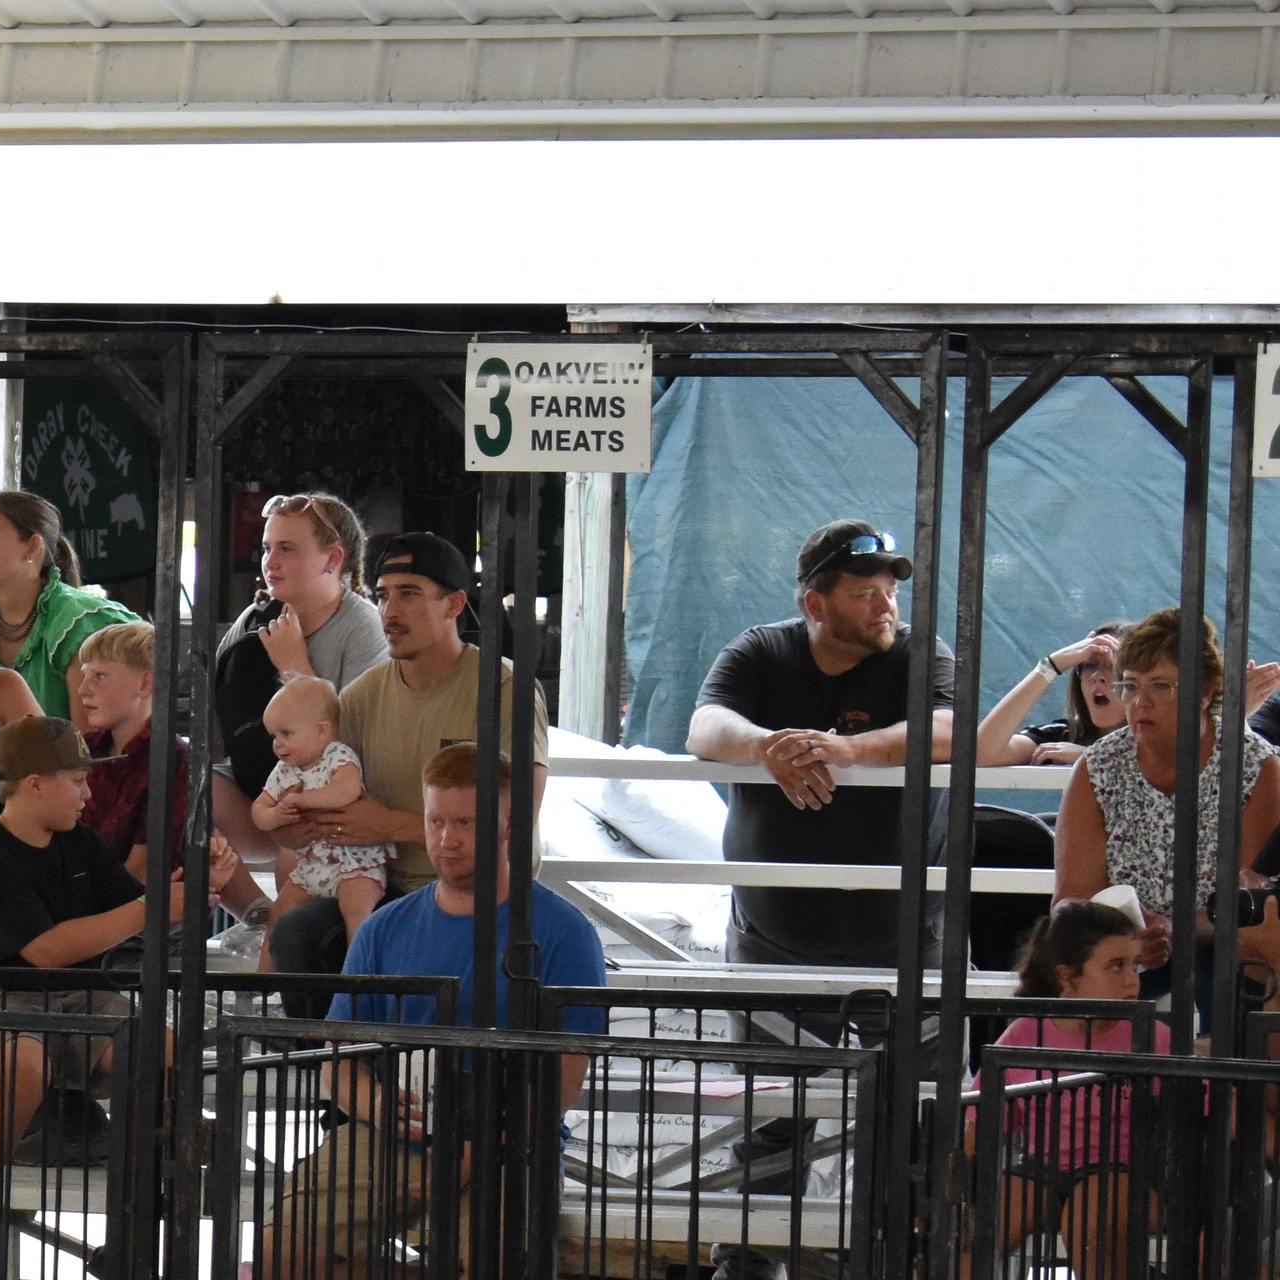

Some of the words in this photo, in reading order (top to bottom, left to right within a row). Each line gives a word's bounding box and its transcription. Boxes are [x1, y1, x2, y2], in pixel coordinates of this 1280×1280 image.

[514, 361, 645, 385] OAKVEIW
[473, 357, 513, 458] 3
[530, 395, 626, 419] FARMS
[24, 402, 65, 481] DARBY
[531, 429, 625, 453] MEATS
[694, 1029, 726, 1038] umb
[675, 1115, 707, 1128] Crub
